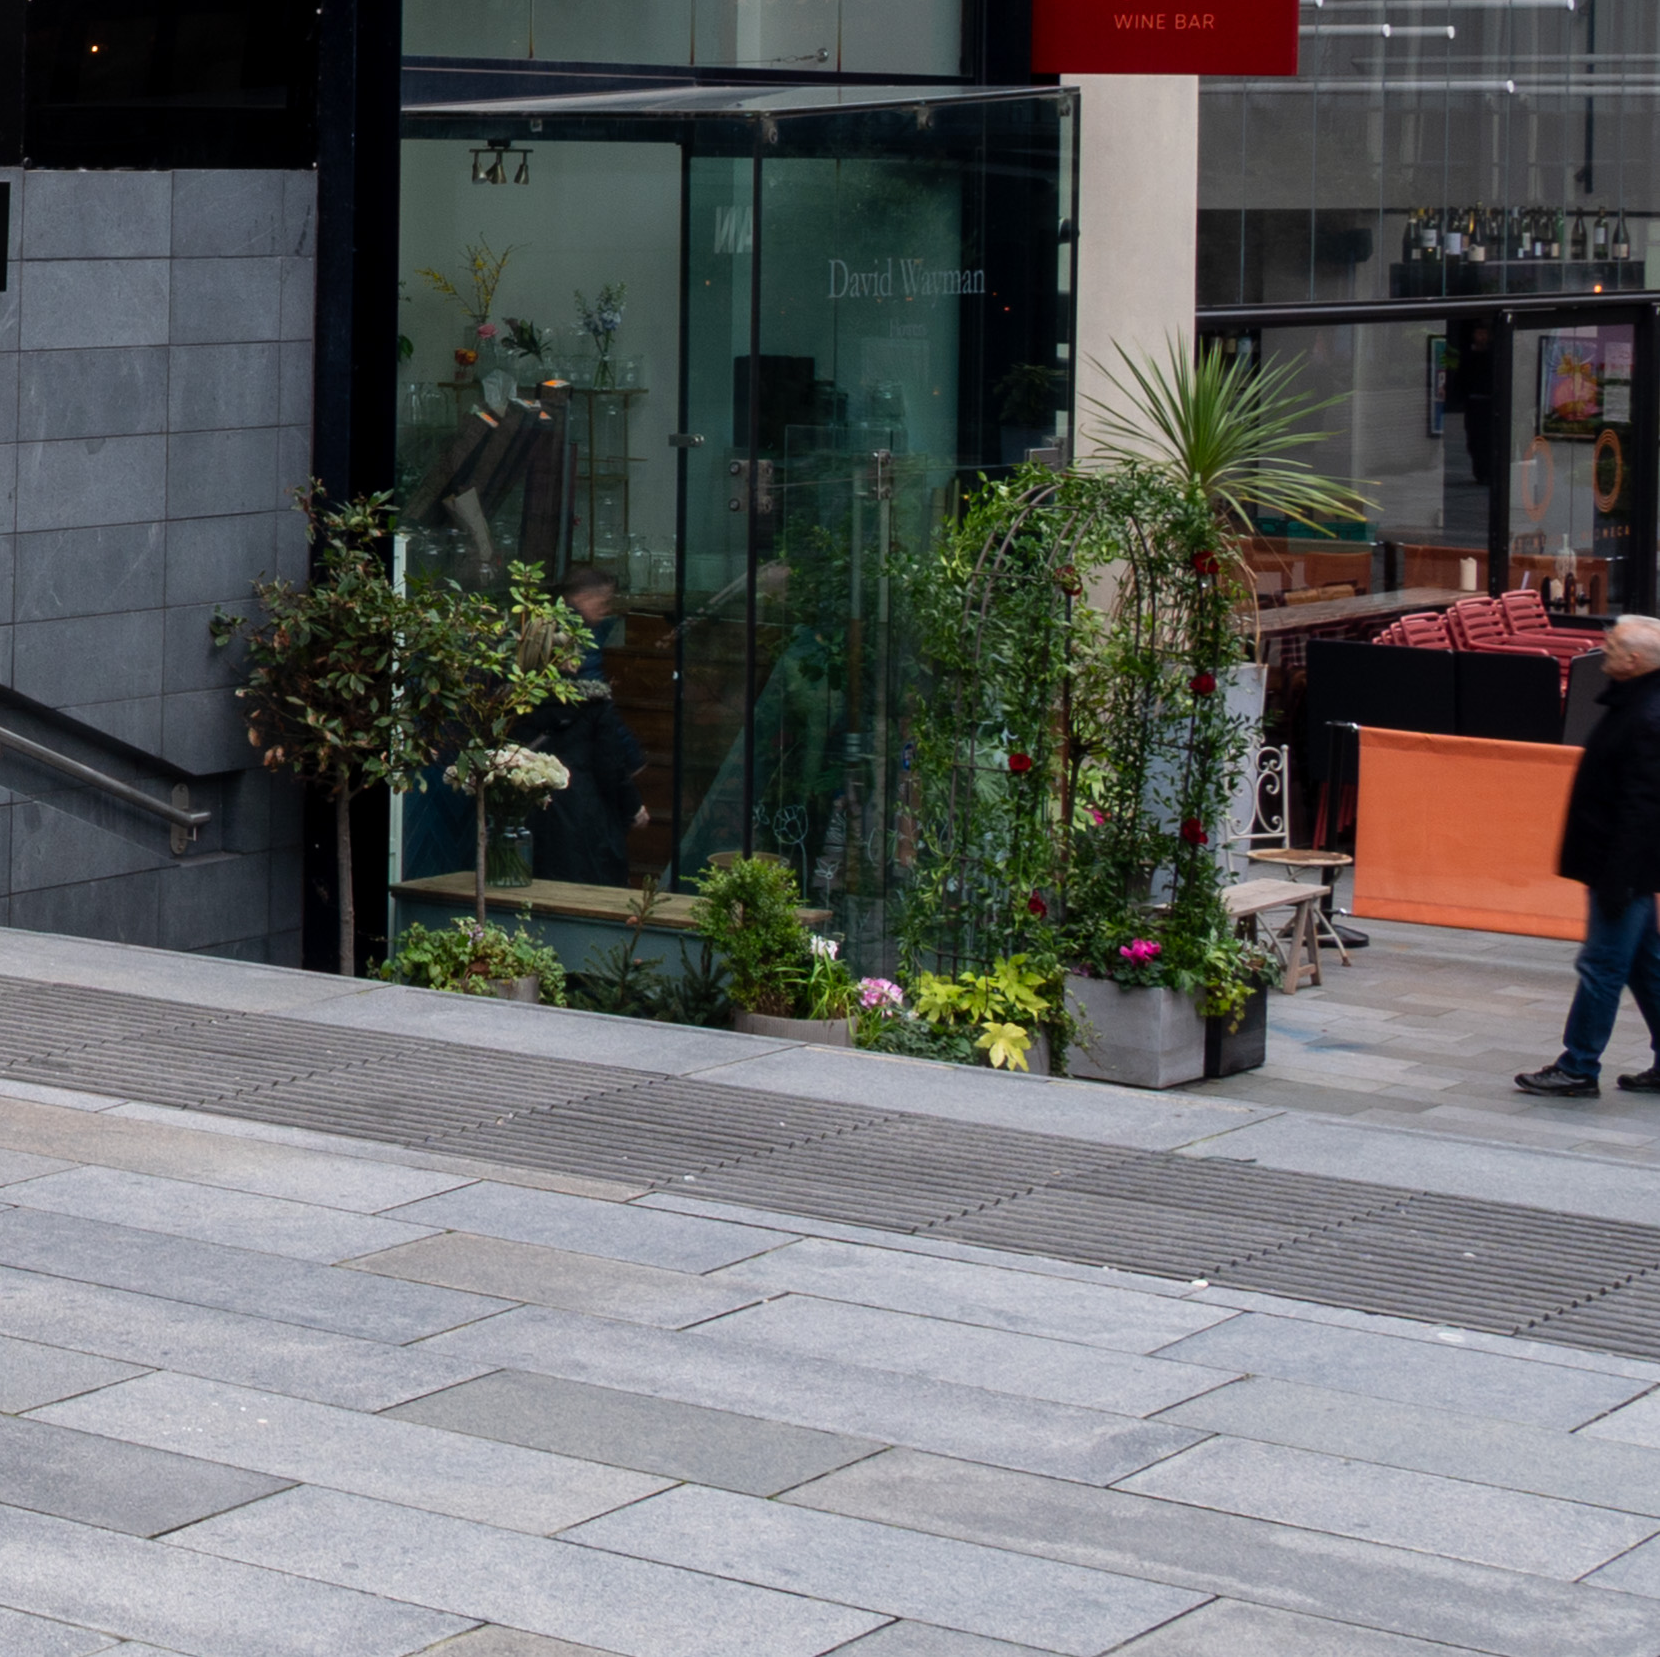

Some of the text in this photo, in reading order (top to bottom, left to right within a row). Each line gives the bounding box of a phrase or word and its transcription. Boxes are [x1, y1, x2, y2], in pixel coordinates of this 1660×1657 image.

[1114, 14, 1215, 29] WINE BAR
[828, 258, 986, 308] David Wayman
